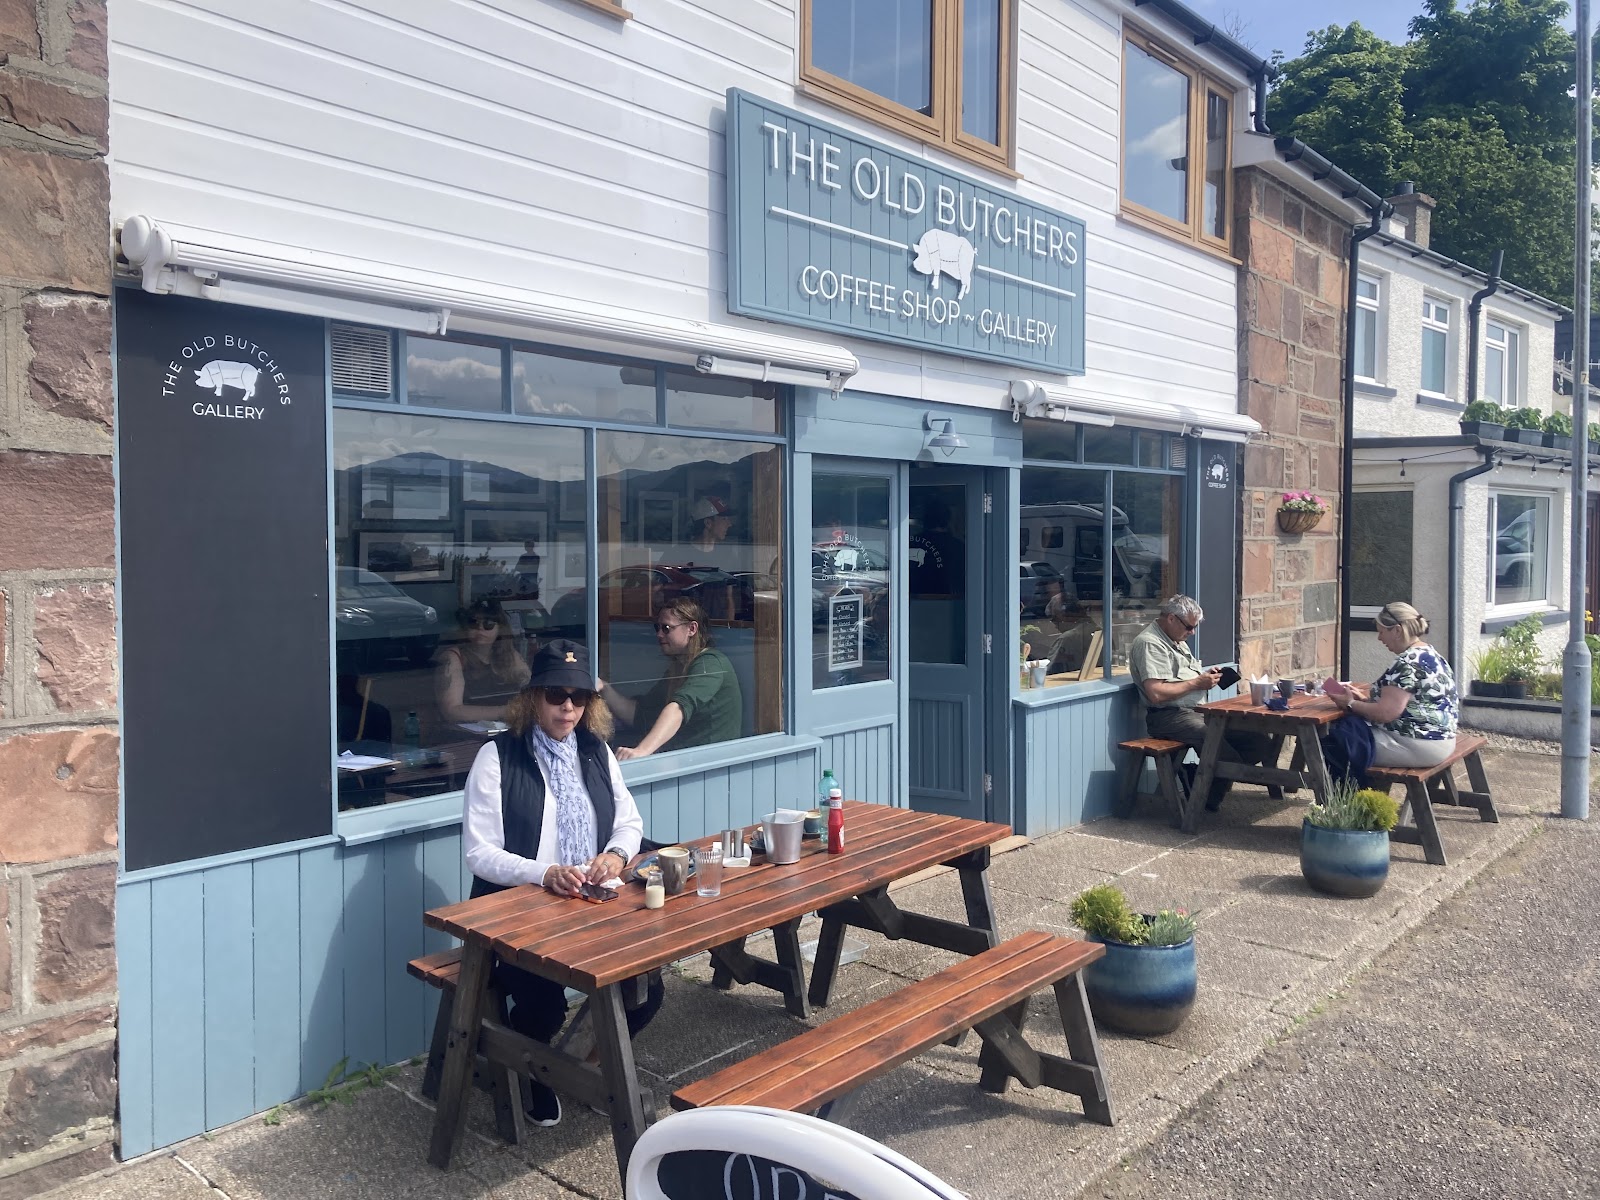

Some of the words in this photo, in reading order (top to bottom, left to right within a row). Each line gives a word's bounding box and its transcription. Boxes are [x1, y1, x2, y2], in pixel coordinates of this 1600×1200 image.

[763, 121, 842, 190] THE
[854, 157, 926, 214] OLD
[938, 184, 1078, 265] BUTCHERS
[802, 265, 896, 314] COFFEE
[902, 289, 960, 326] SHOP
[981, 308, 1057, 347] GALLERY
[162, 361, 183, 396] THE
[181, 336, 216, 359] OLD
[225, 335, 291, 405] BUTCHERS
[192, 402, 265, 420] GALLERY
[829, 535, 843, 550] OLD
[845, 533, 871, 572] BUTCHERS
[910, 536, 944, 568] BUTCHERS
